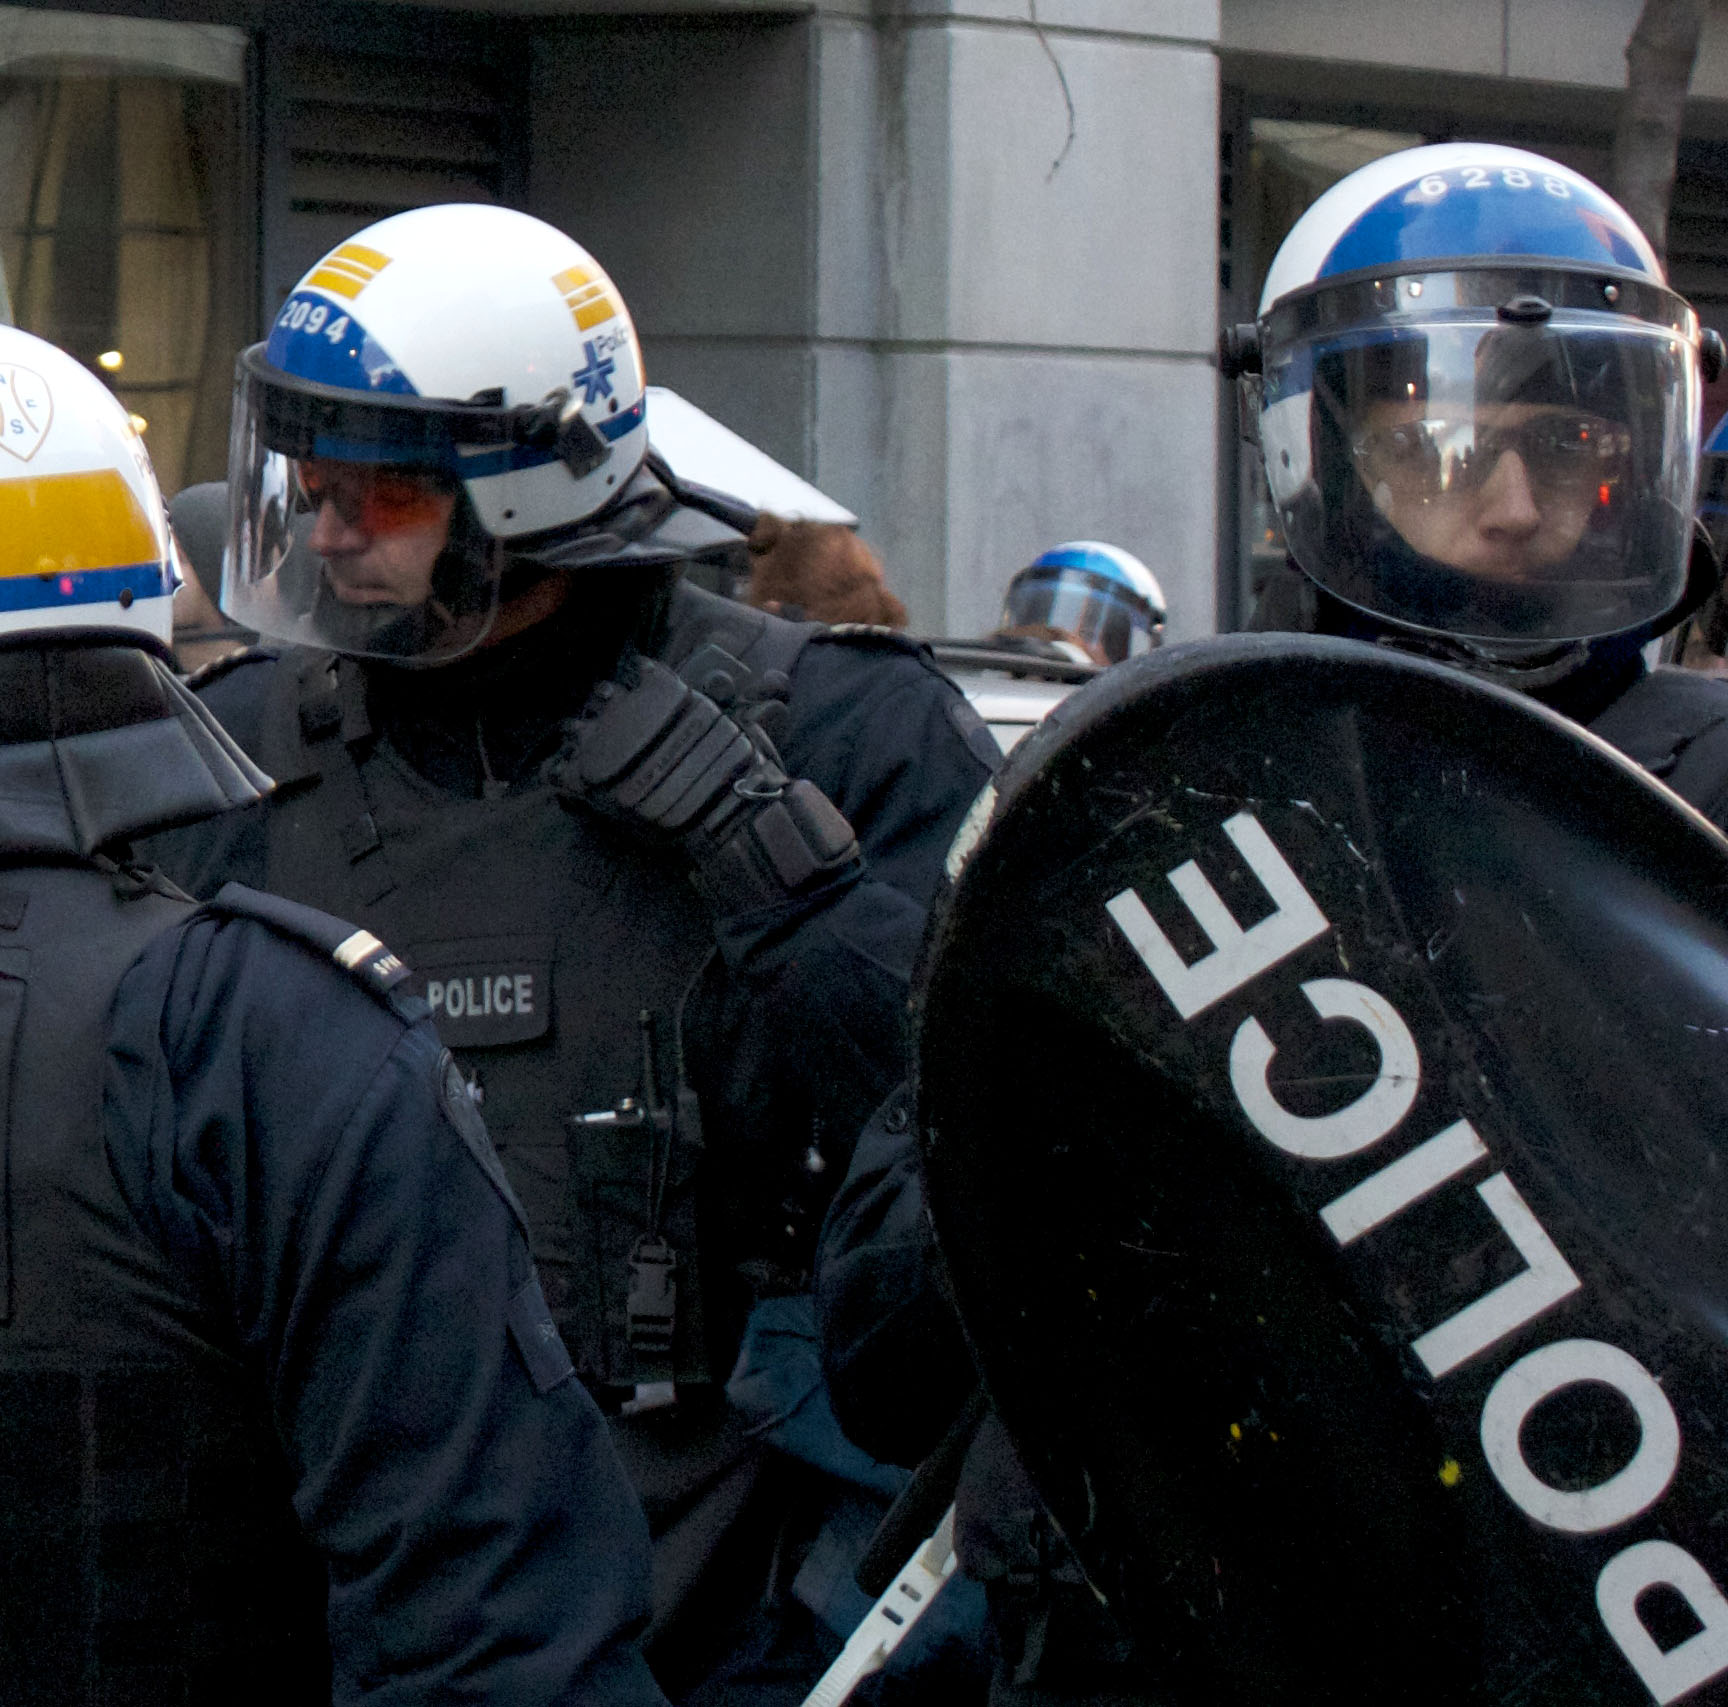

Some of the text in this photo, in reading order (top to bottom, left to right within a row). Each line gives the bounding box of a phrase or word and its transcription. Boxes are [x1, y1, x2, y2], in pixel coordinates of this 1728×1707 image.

[1419, 168, 1571, 198] 6288
[279, 301, 350, 344] 2094
[10, 418, 25, 434] S
[428, 974, 533, 1017] POLICE
[1105, 810, 1728, 1706] POLICE
